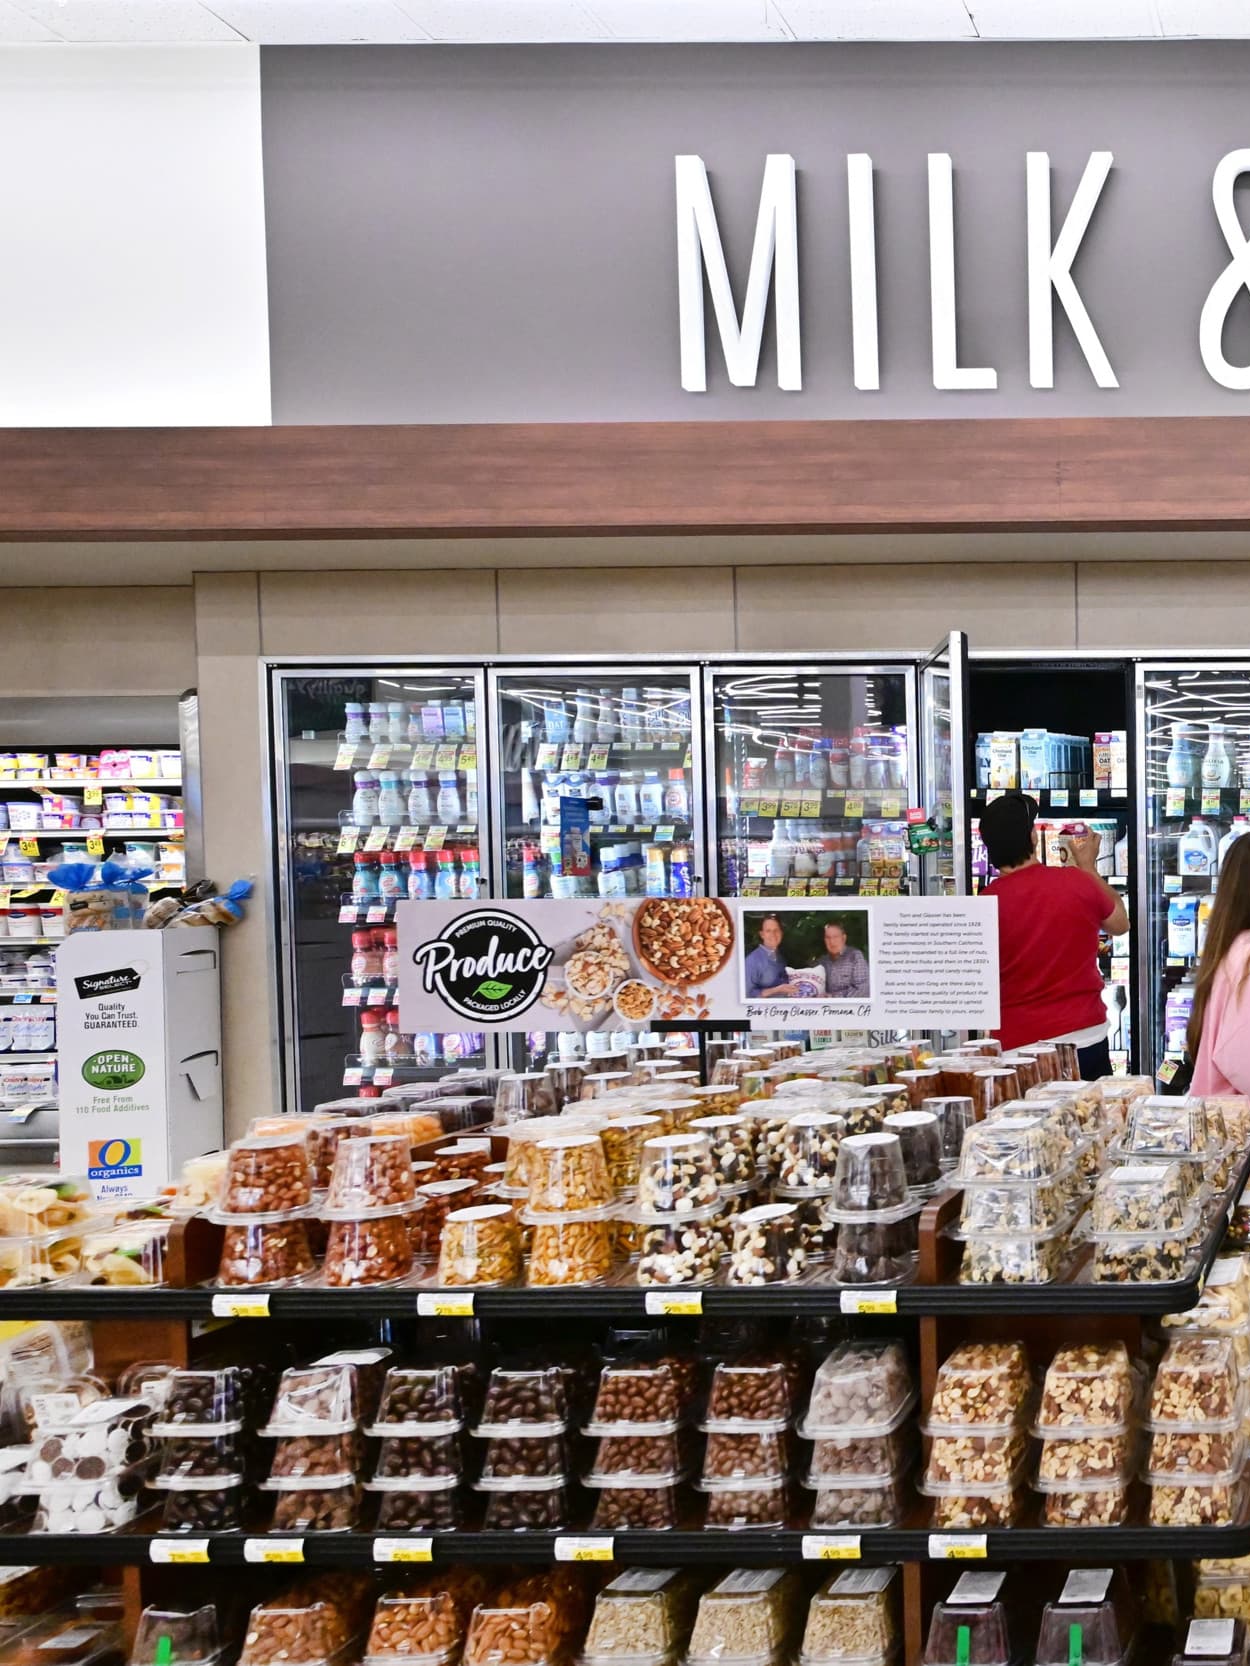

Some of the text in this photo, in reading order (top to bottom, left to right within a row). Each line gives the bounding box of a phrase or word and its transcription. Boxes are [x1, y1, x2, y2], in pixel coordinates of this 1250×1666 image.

[675, 151, 1120, 392] MILK
[455, 919, 518, 938] PREMIUM QUALITY
[415, 935, 553, 991] Produce
[82, 976, 132, 990] Signature
[463, 989, 527, 1012] PACKAGED LOCALLY
[98, 1003, 125, 1011] Quality
[857, 1005, 871, 1016] CA
[101, 1012, 115, 1020] Can
[870, 1030, 898, 1048] Silk
[97, 1054, 129, 1065] OPEN
[91, 1064, 136, 1074] NATURE
[93, 1096, 110, 1104] Free
[92, 1105, 110, 1113] Food
[114, 1104, 150, 1112] Additives
[90, 1166, 139, 1178] organics
[101, 1185, 128, 1193] Always
